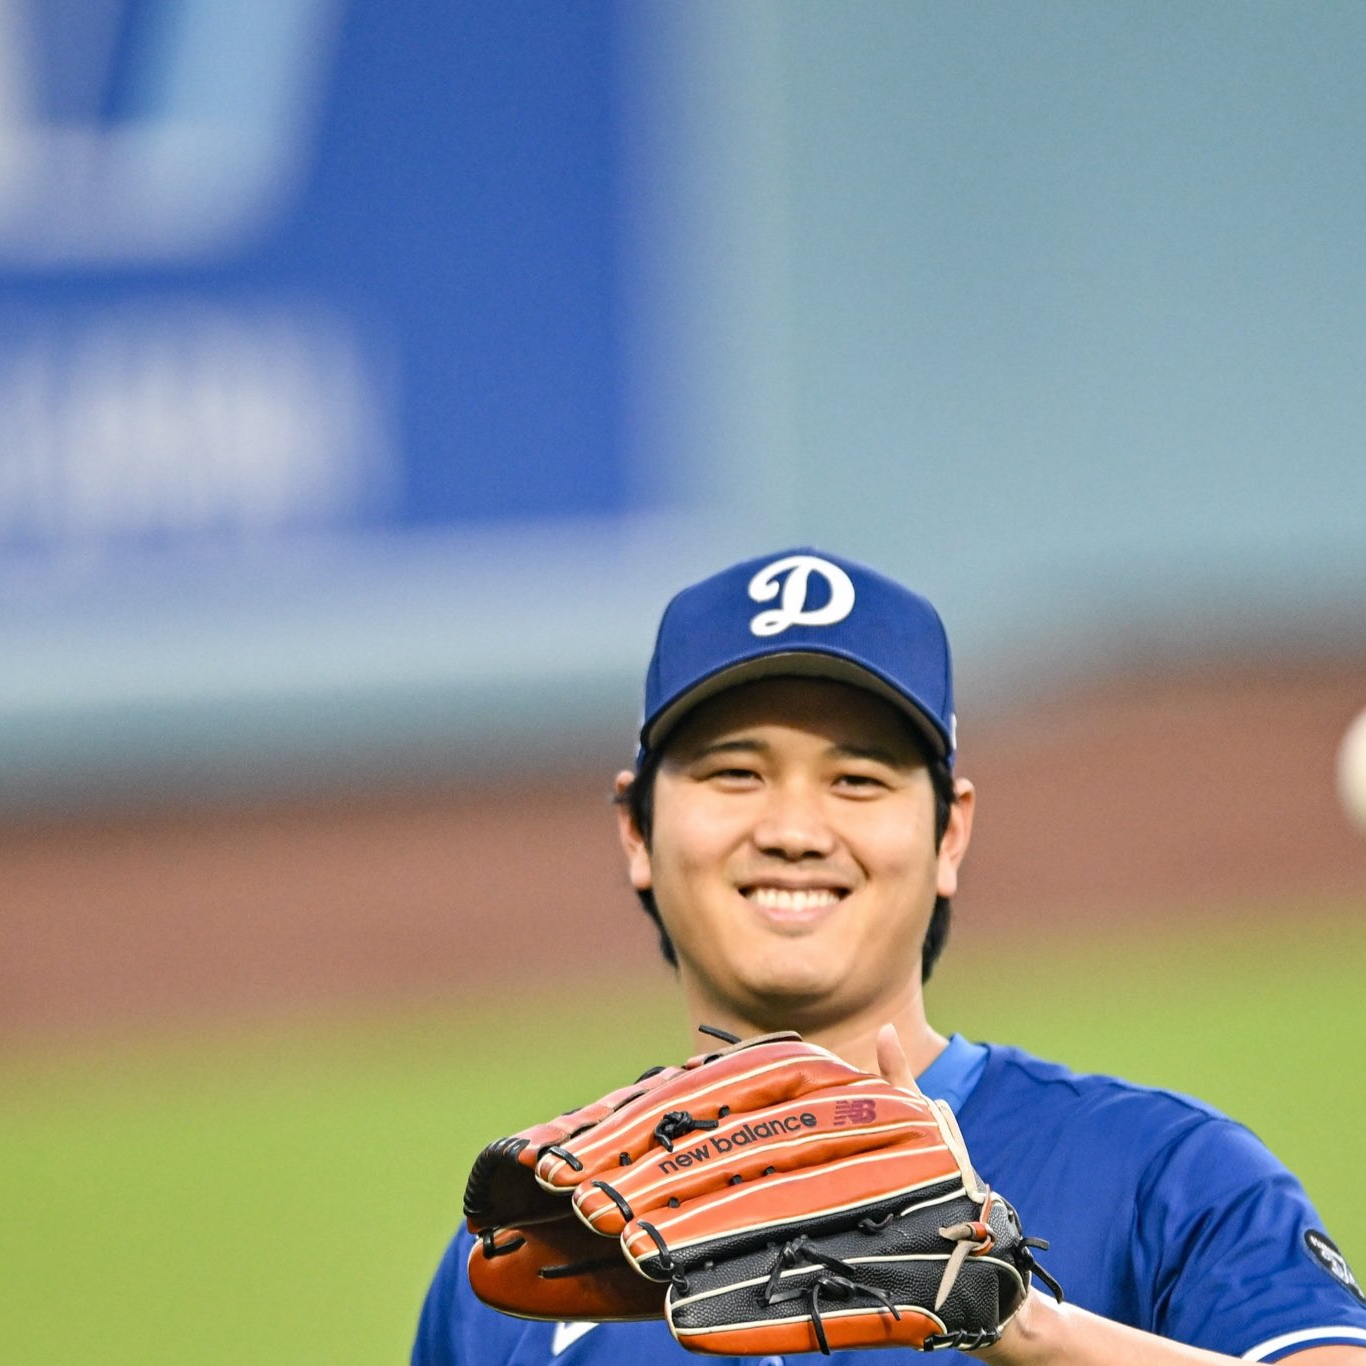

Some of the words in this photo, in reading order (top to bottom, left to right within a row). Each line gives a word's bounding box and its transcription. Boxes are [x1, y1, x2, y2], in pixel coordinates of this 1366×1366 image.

[748, 555, 856, 637] D
[657, 1144, 710, 1175] new
[709, 1112, 818, 1154] balance
